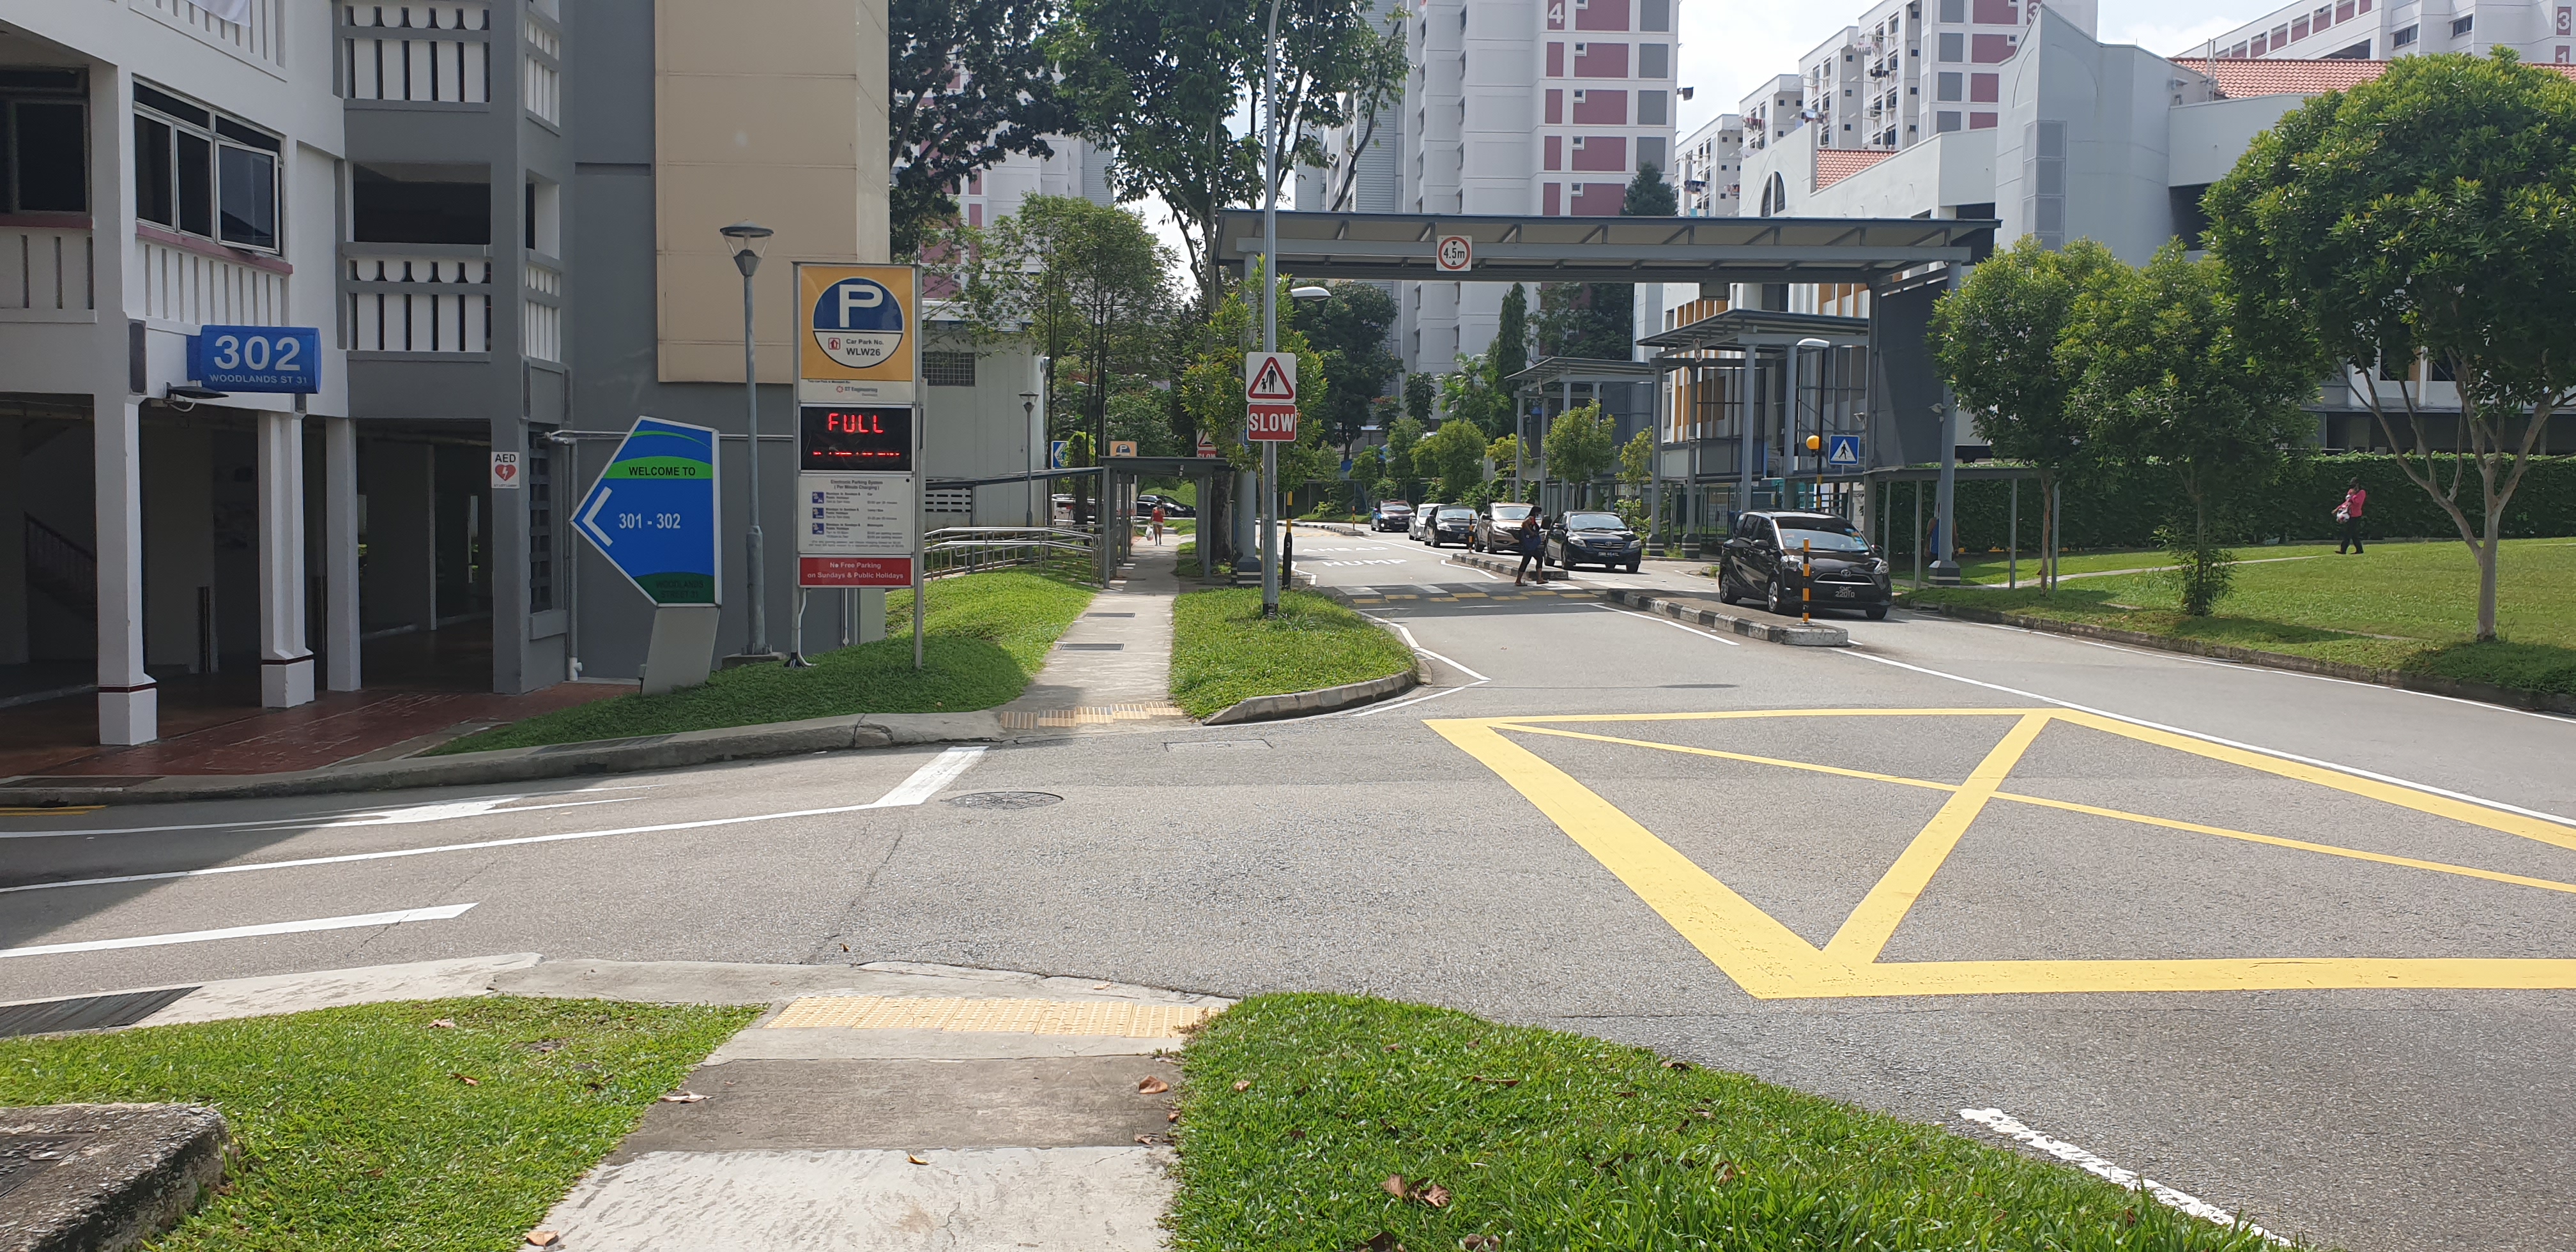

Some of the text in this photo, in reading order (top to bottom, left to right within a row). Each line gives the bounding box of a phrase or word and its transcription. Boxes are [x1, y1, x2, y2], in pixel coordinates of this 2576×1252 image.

[1548, 3, 1564, 24] 4
[2557, 11, 2570, 30] 3
[1443, 247, 1465, 259] 4.5m
[839, 284, 884, 328] P
[214, 335, 300, 370] 302
[846, 347, 880, 356] WLW26
[210, 374, 278, 383] WOODLANDS
[296, 376, 307, 384] 31
[828, 413, 884, 433] FULL
[1249, 413, 1294, 432] SLOW
[1119, 445, 1128, 453] P
[494, 454, 516, 462] AED
[629, 467, 696, 476] WELCOME TO
[619, 514, 642, 529] 301
[656, 514, 681, 529] 302
[1322, 558, 1407, 567] HUMP
